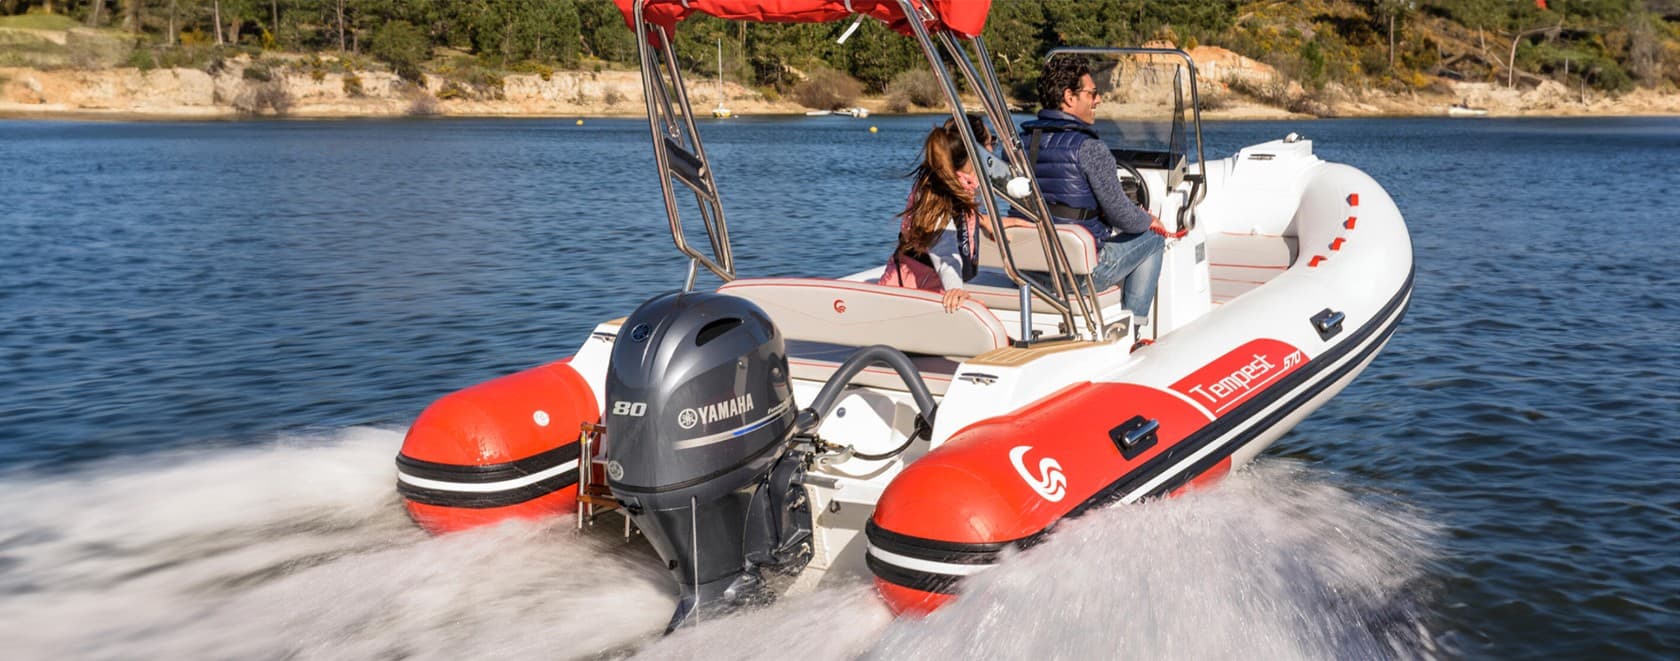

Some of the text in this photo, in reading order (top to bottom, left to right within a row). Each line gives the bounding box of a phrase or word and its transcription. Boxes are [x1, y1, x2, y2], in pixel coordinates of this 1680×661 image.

[1188, 350, 1301, 403] Tempest 570
[612, 401, 647, 417] 80
[698, 393, 754, 424] YAMAHA
